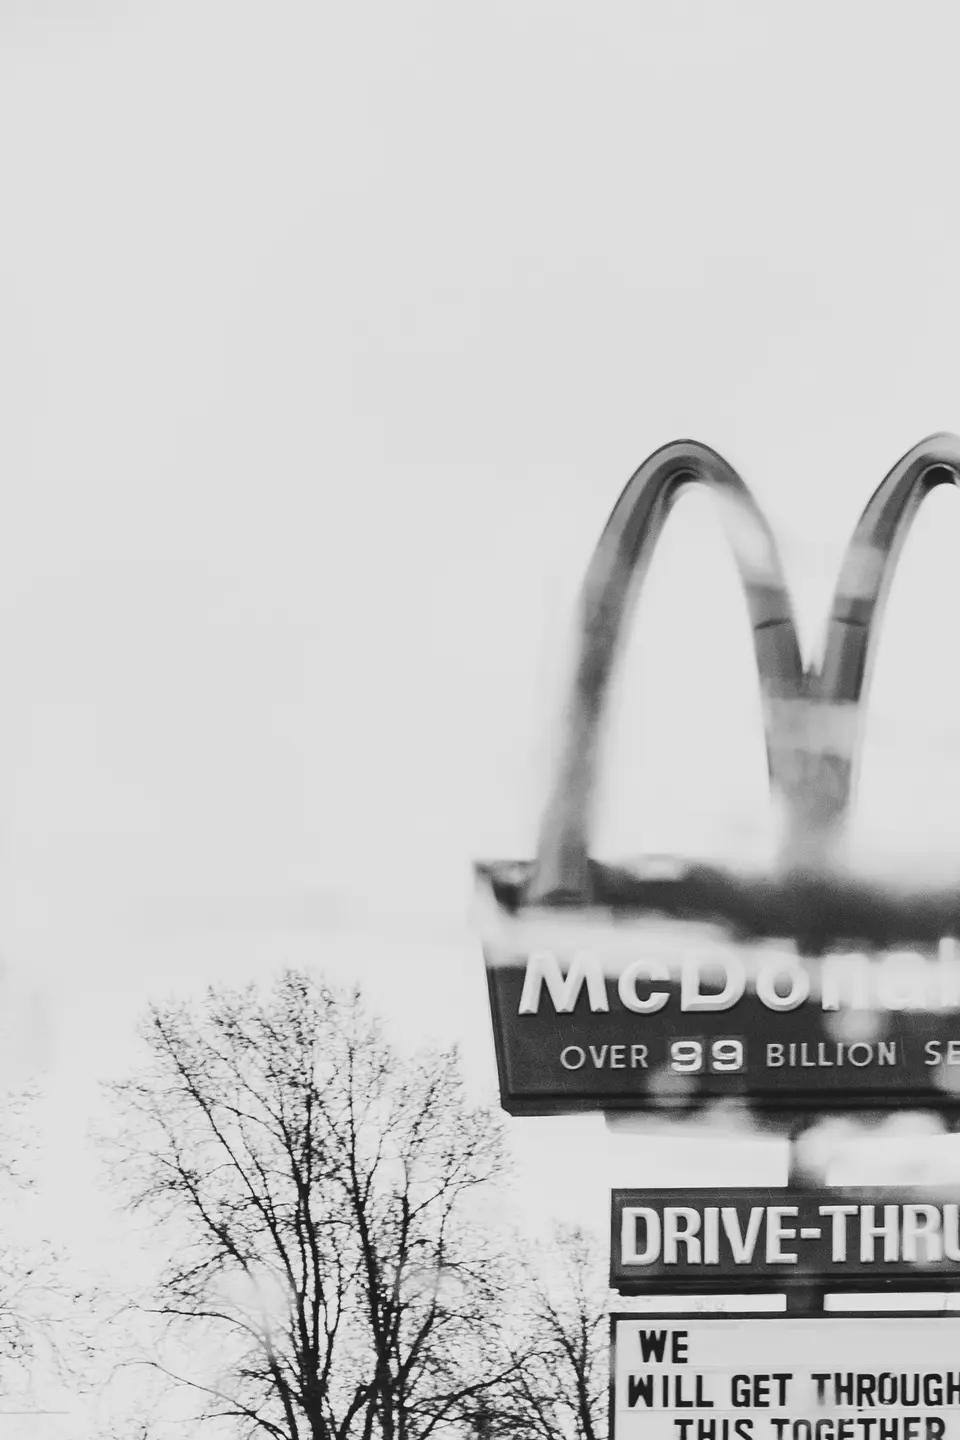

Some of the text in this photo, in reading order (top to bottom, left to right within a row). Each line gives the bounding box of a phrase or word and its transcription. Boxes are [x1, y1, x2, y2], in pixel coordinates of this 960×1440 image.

[560, 1044, 649, 1070] OVER
[669, 1039, 744, 1072] 99
[766, 1042, 897, 1068] BILLION
[639, 1330, 689, 1364] WE
[627, 1373, 714, 1408] WILL
[731, 1373, 793, 1408] GET
